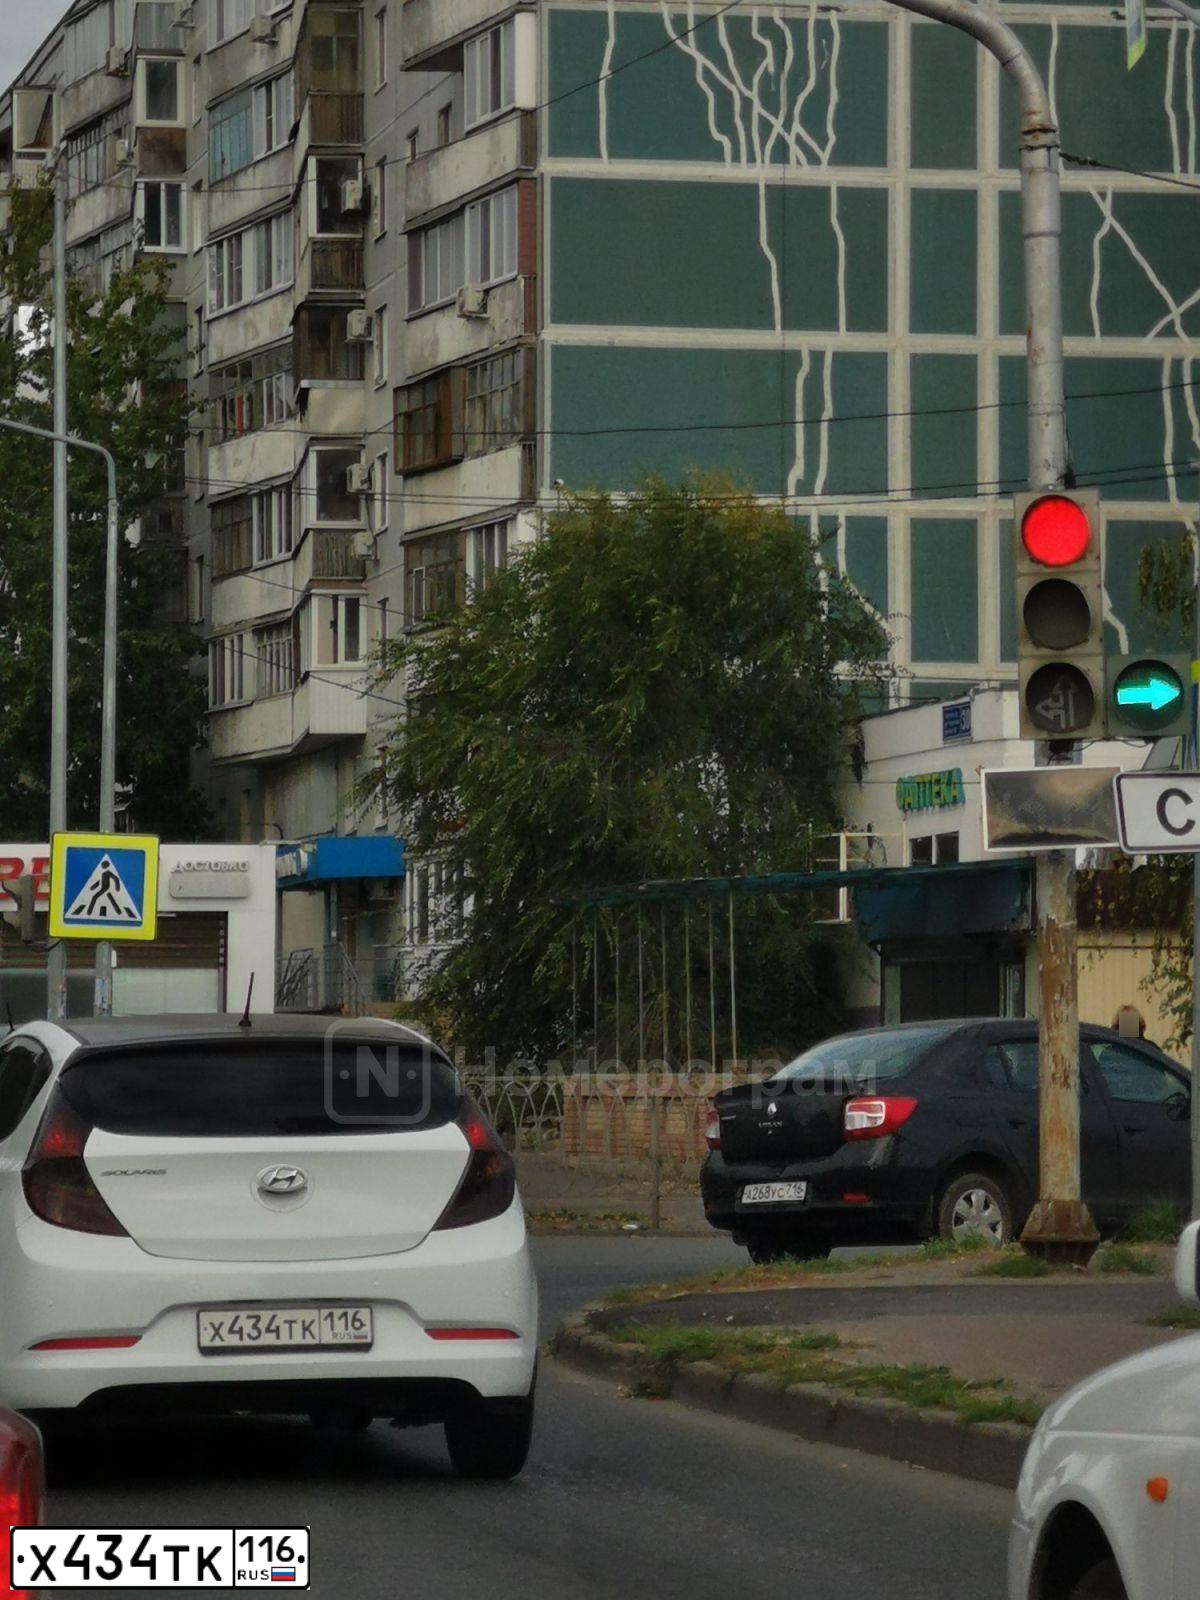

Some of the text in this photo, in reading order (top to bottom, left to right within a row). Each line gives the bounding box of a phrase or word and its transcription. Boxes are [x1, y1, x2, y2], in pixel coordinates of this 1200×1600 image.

[100, 1168, 167, 1177] SOLARIS
[209, 1310, 364, 1342] Х434ТК 116
